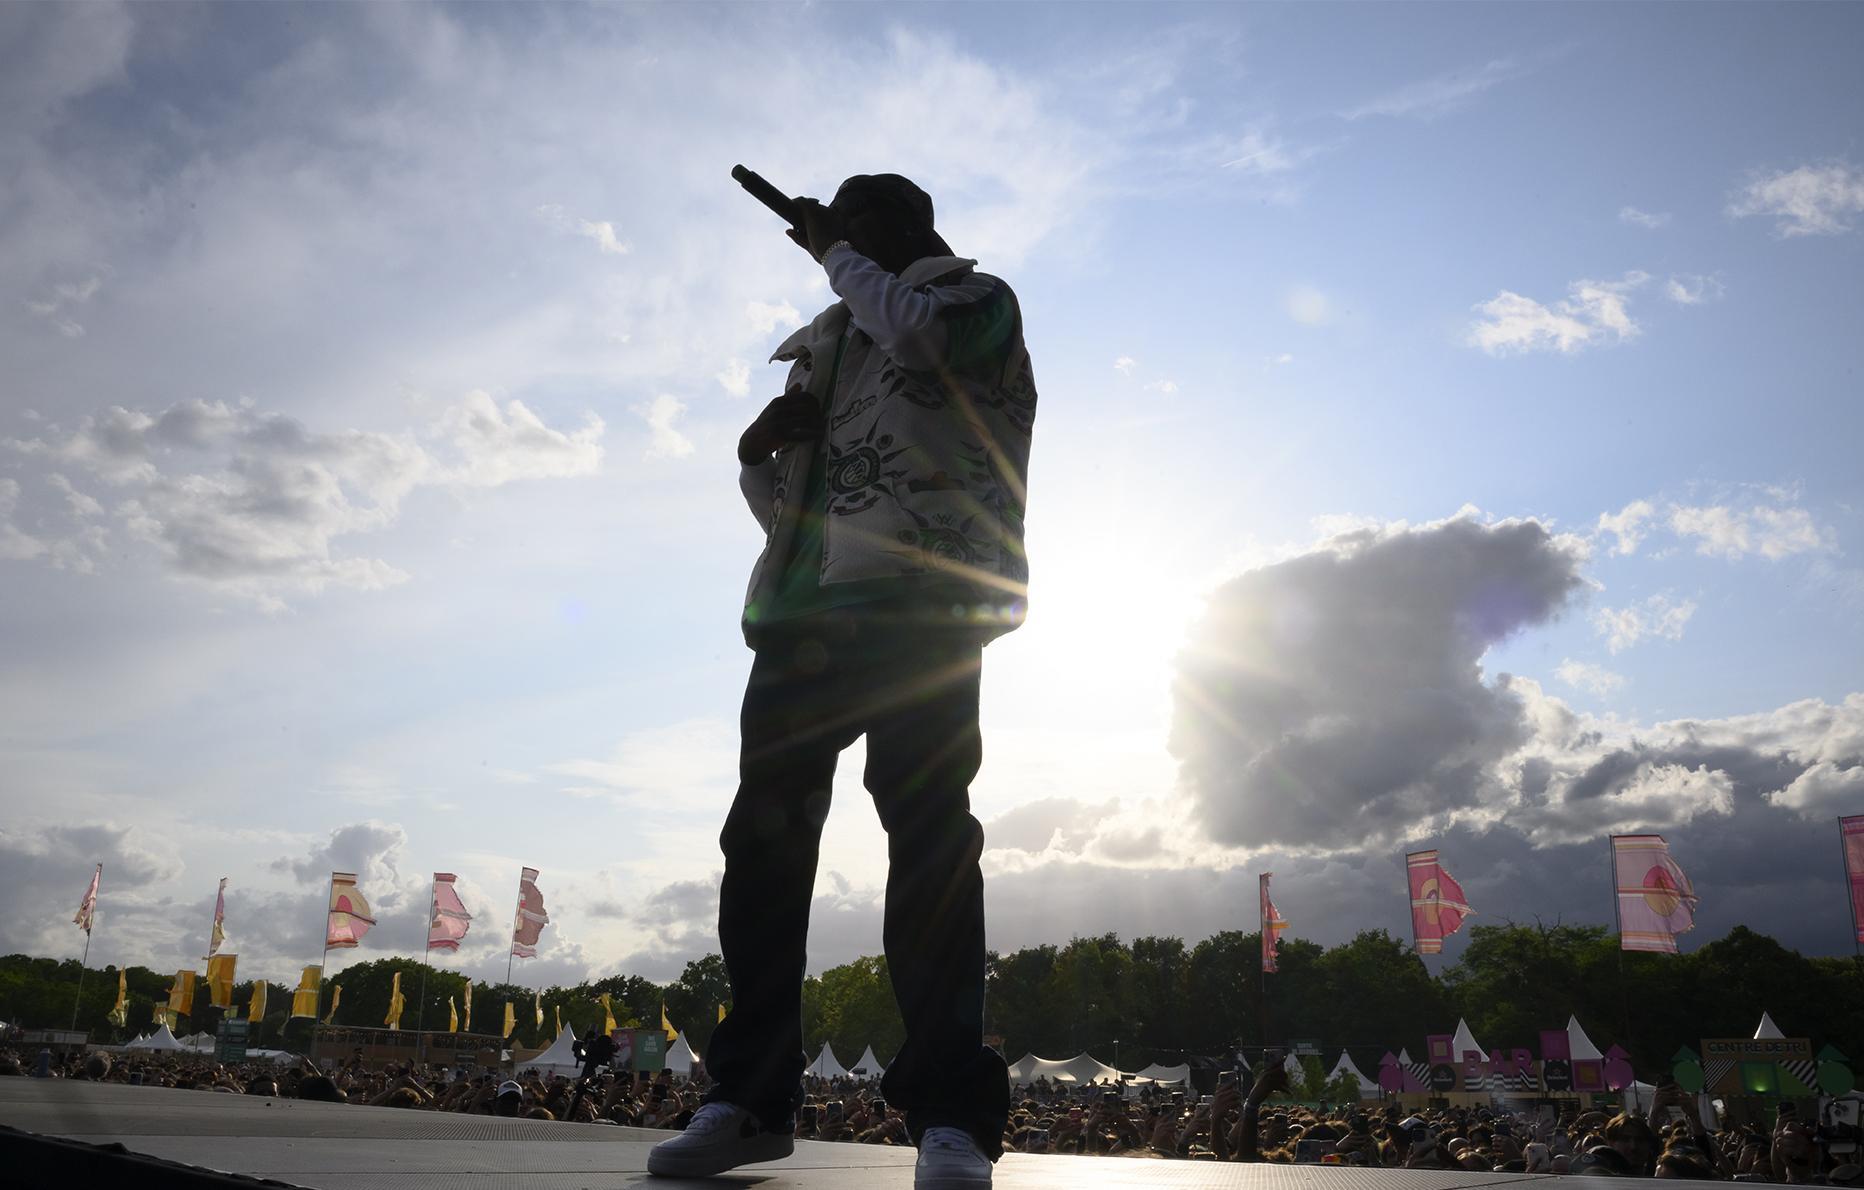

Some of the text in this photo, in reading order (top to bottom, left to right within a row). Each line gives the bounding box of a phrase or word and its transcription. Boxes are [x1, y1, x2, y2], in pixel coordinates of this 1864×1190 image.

[1708, 1041, 1807, 1053] CENTRE DE TRI
[1463, 1048, 1538, 1091] BAR
